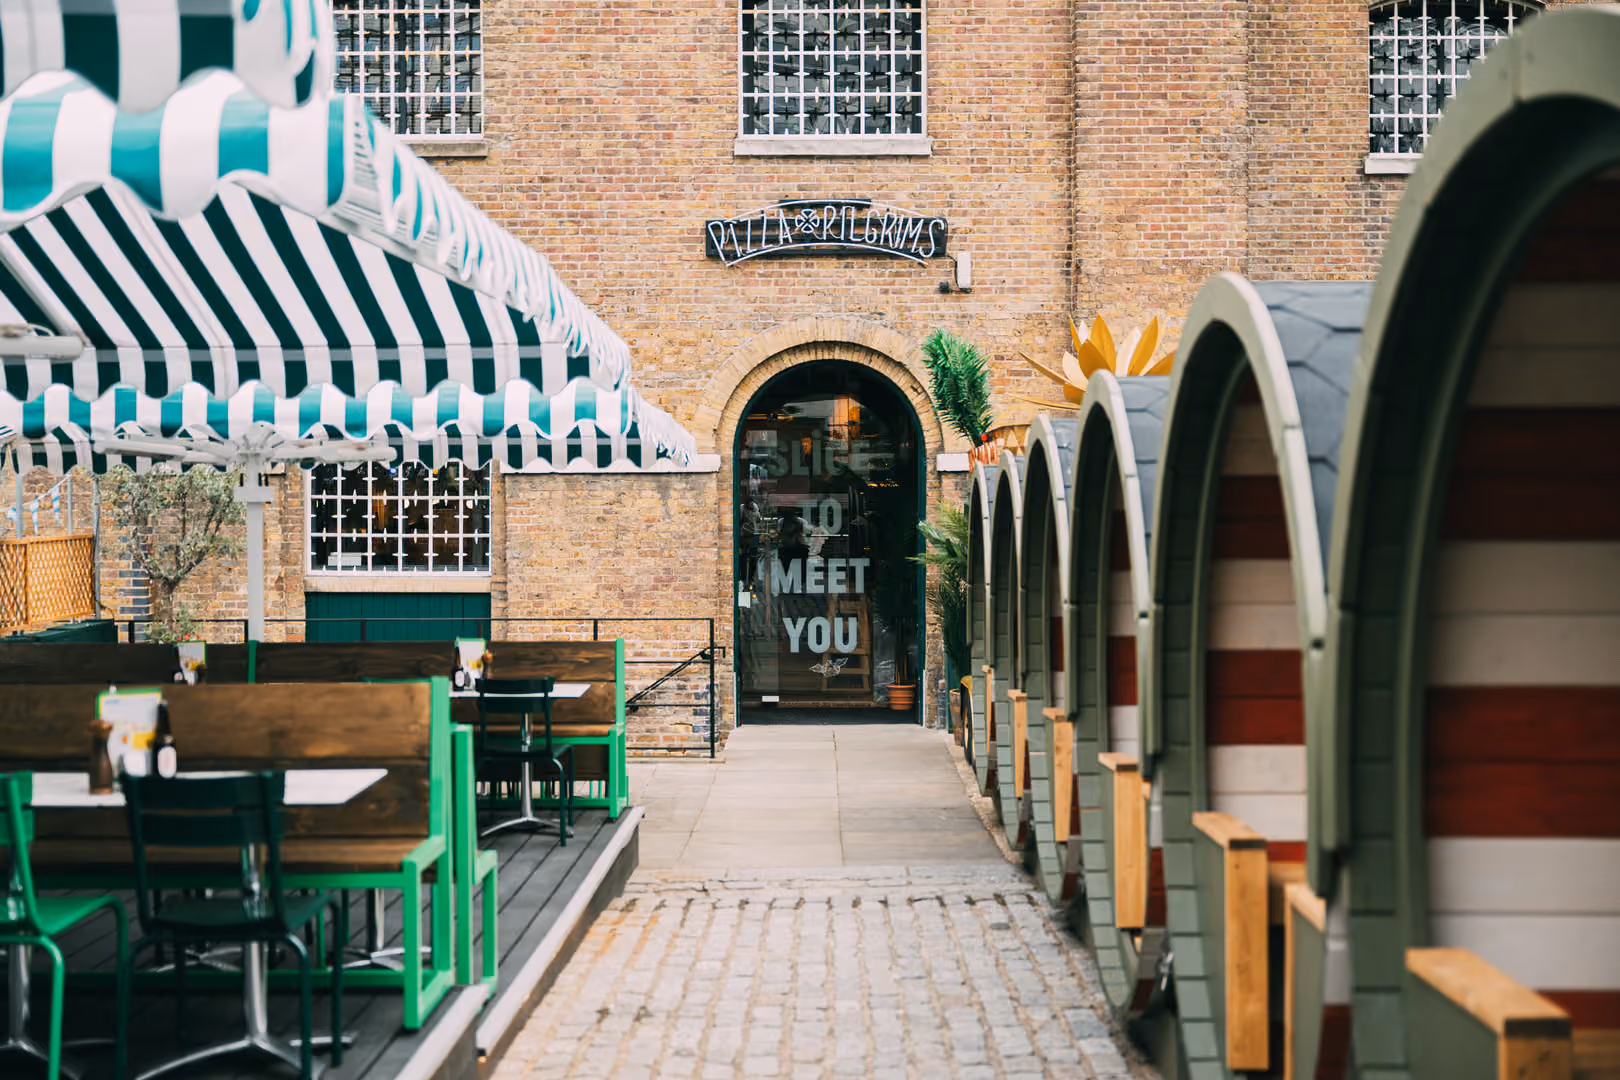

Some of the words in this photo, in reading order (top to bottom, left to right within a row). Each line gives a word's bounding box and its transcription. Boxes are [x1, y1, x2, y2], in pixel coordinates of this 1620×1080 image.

[707, 207, 793, 262] PIZZA
[822, 204, 945, 258] PILGRIMS
[796, 498, 843, 535] TO
[775, 557, 871, 594] MEET
[782, 616, 858, 654] YOU
